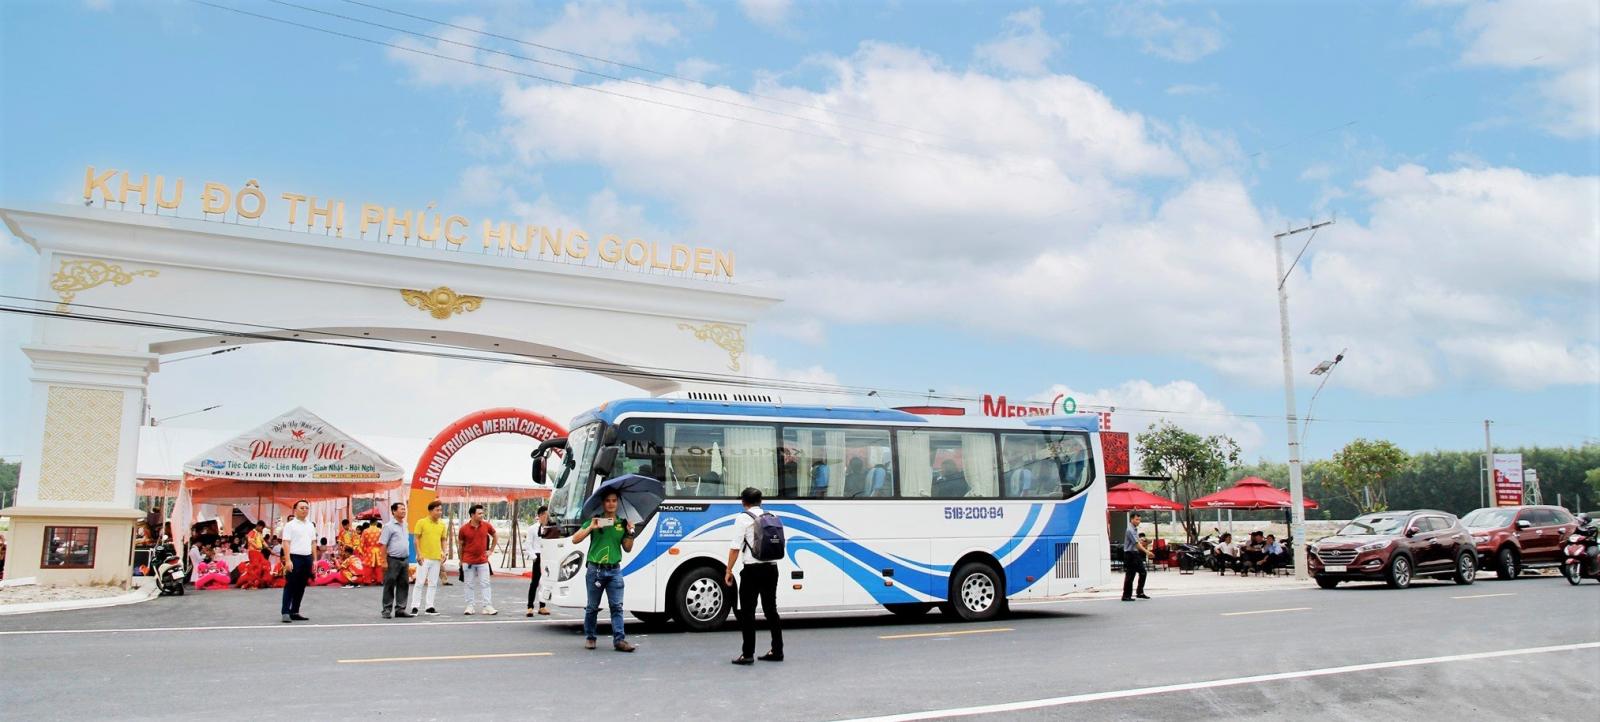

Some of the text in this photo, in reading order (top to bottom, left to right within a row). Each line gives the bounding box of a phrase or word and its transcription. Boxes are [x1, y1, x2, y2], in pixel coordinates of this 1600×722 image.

[82, 165, 735, 278] KHU ĐÔ THỊ PHÚC HƯNG GOLDEN
[249, 440, 345, 463] Phương Nhi
[426, 452, 447, 480] KHAI
[482, 417, 520, 433] MERRY
[519, 419, 559, 441] COFFEE
